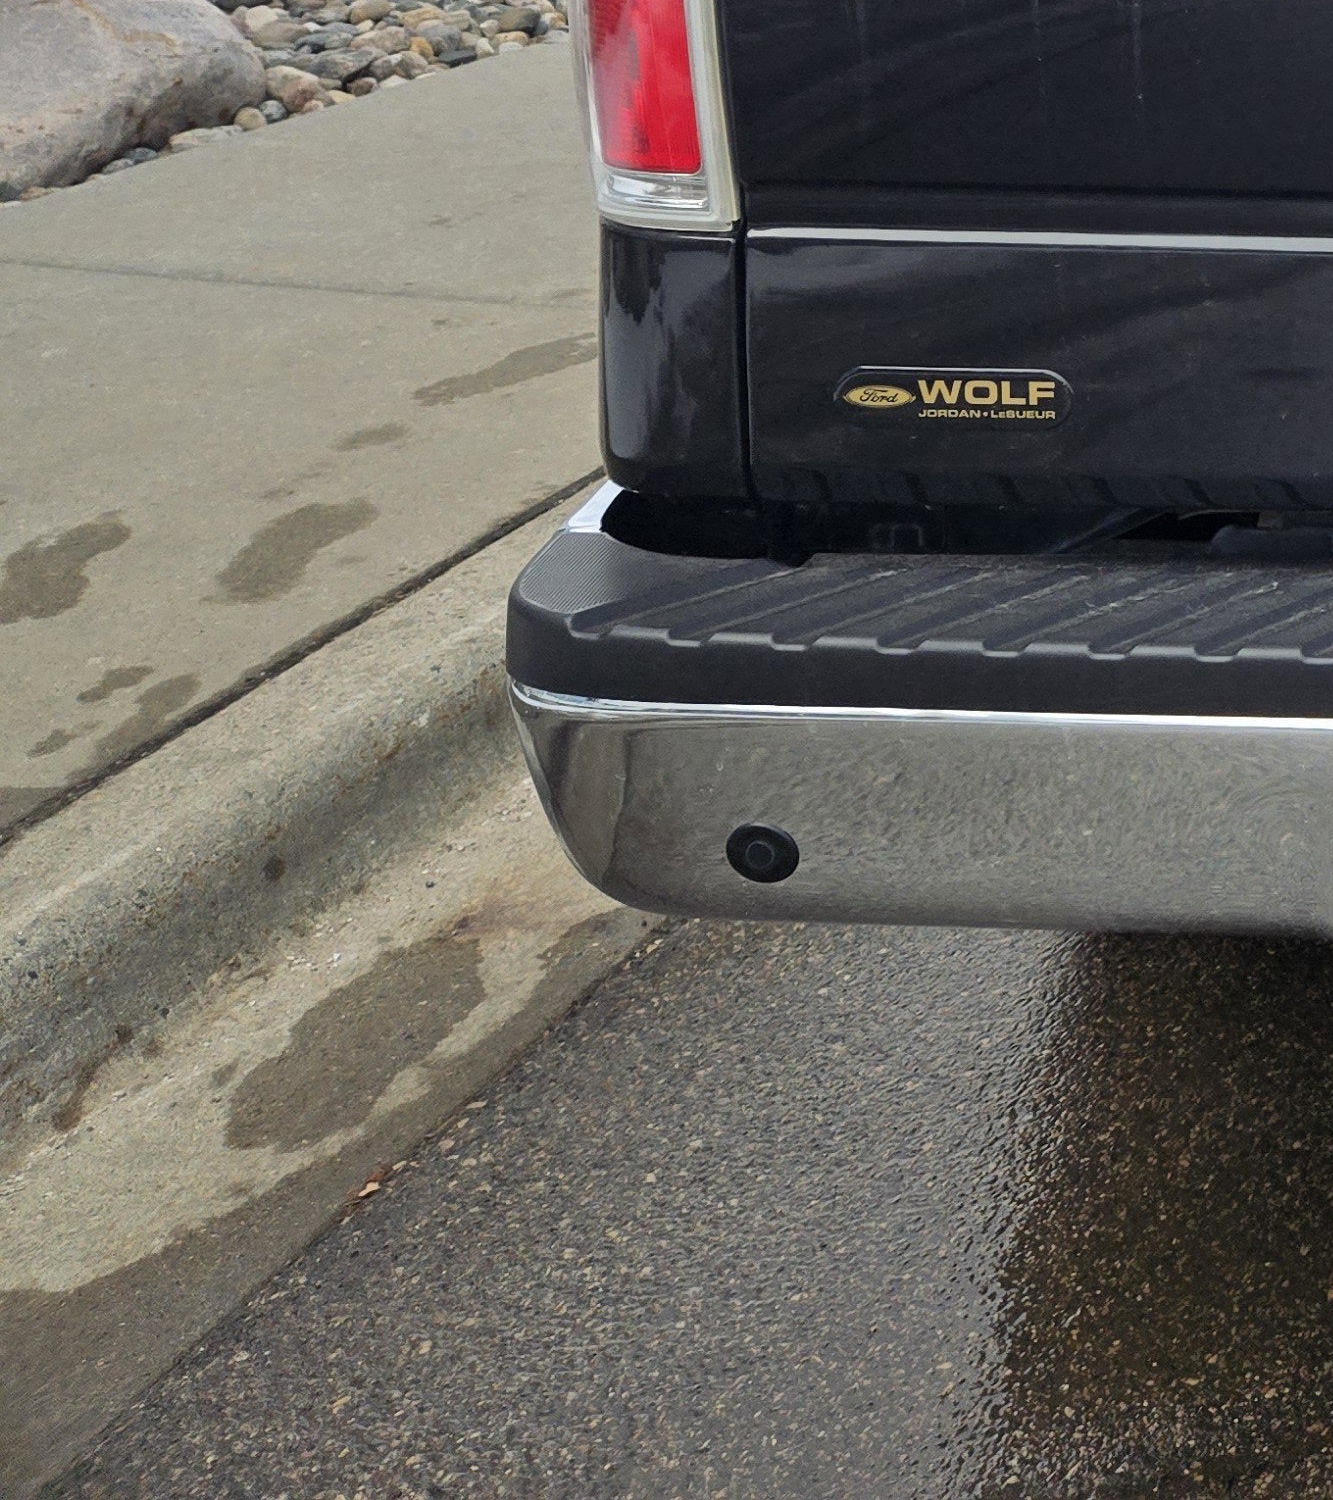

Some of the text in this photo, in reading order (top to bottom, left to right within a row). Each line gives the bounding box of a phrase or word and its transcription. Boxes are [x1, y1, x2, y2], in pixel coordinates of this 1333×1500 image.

[858, 388, 899, 405] Ford
[917, 379, 1056, 406] WOLF
[918, 408, 981, 419] JORDAN
